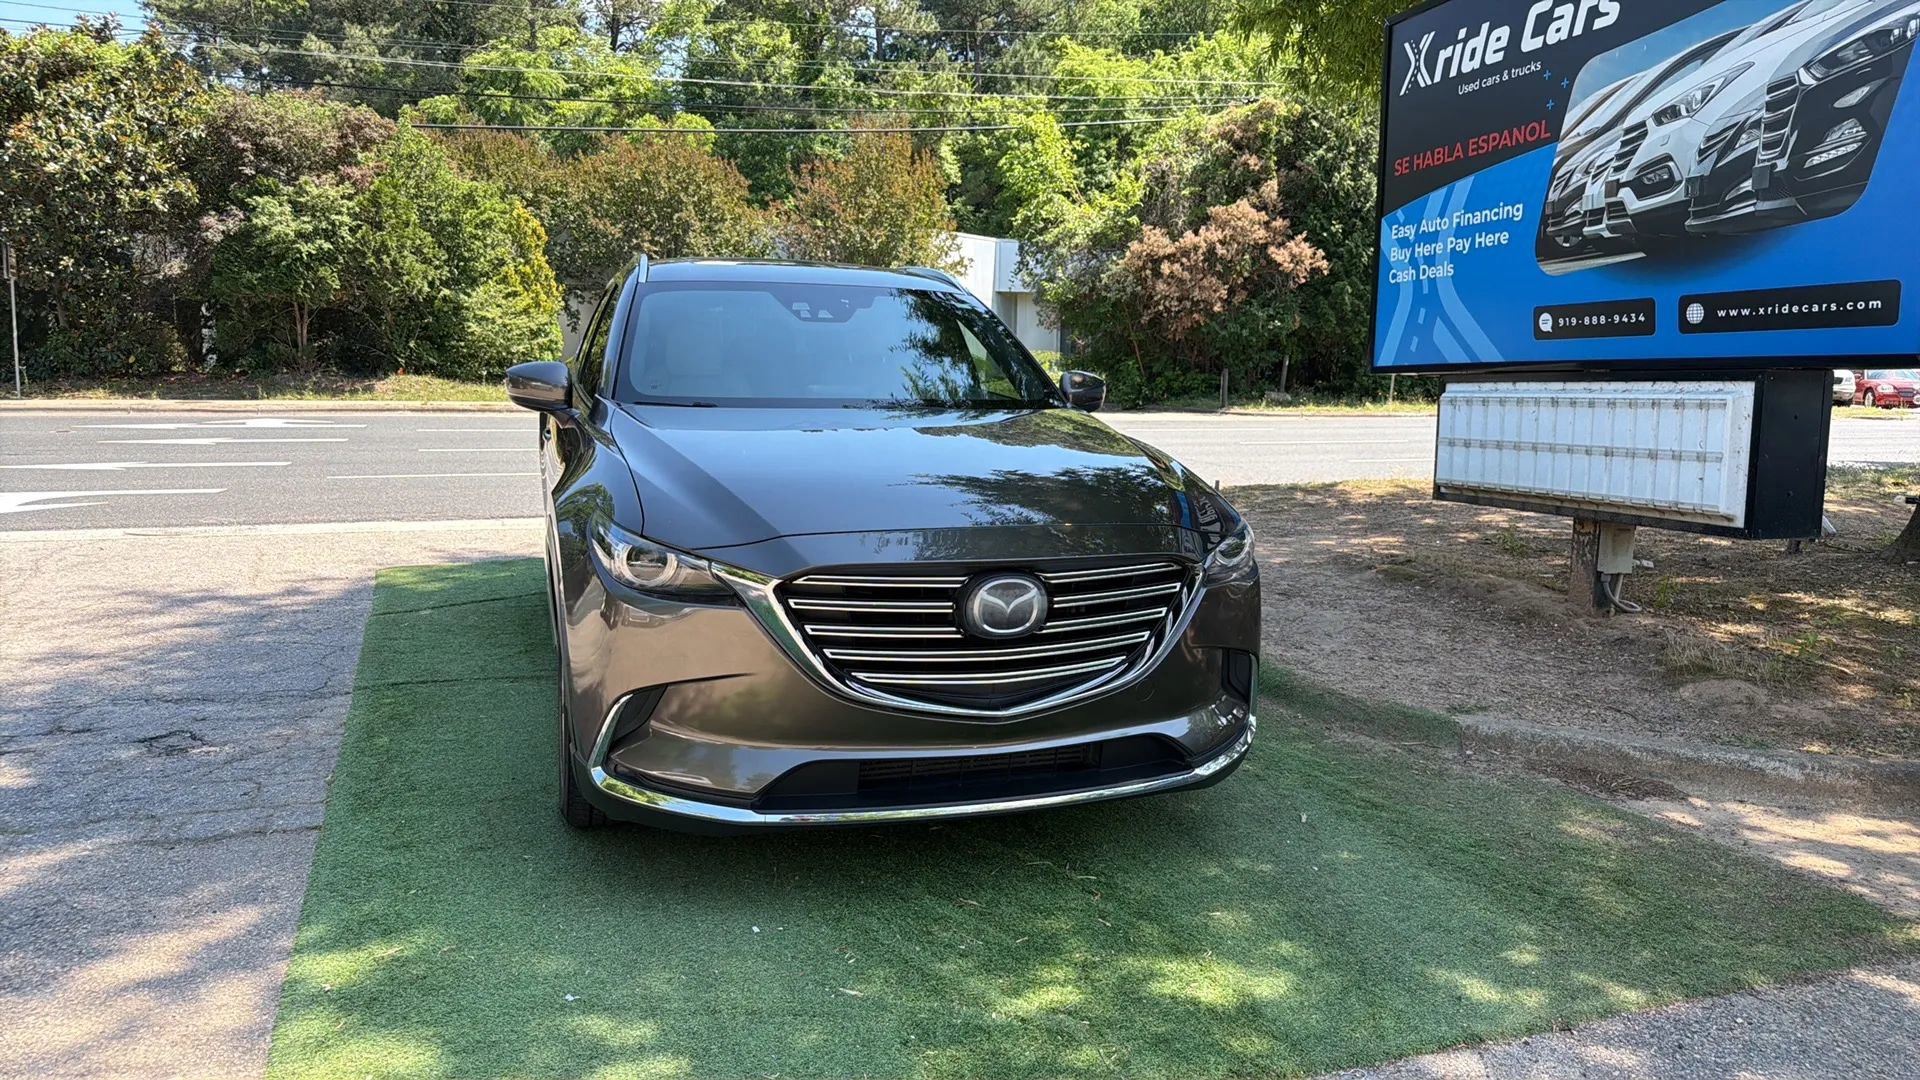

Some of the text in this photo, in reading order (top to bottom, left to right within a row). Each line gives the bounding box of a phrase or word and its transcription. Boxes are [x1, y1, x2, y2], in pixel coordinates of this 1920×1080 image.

[1520, 0, 1621, 53] Cars
[1458, 60, 1542, 95] Used cars & trucks
[1394, 120, 1552, 176] SE HABLA ESPANOL
[1391, 202, 1523, 240] Easy Auto Financing
[1390, 231, 1510, 263] Buy Here Pay Here
[1389, 261, 1455, 284] Cash Deals
[1558, 312, 1646, 327] 919-888-9434
[1716, 298, 1883, 318] www.xridecars.com
